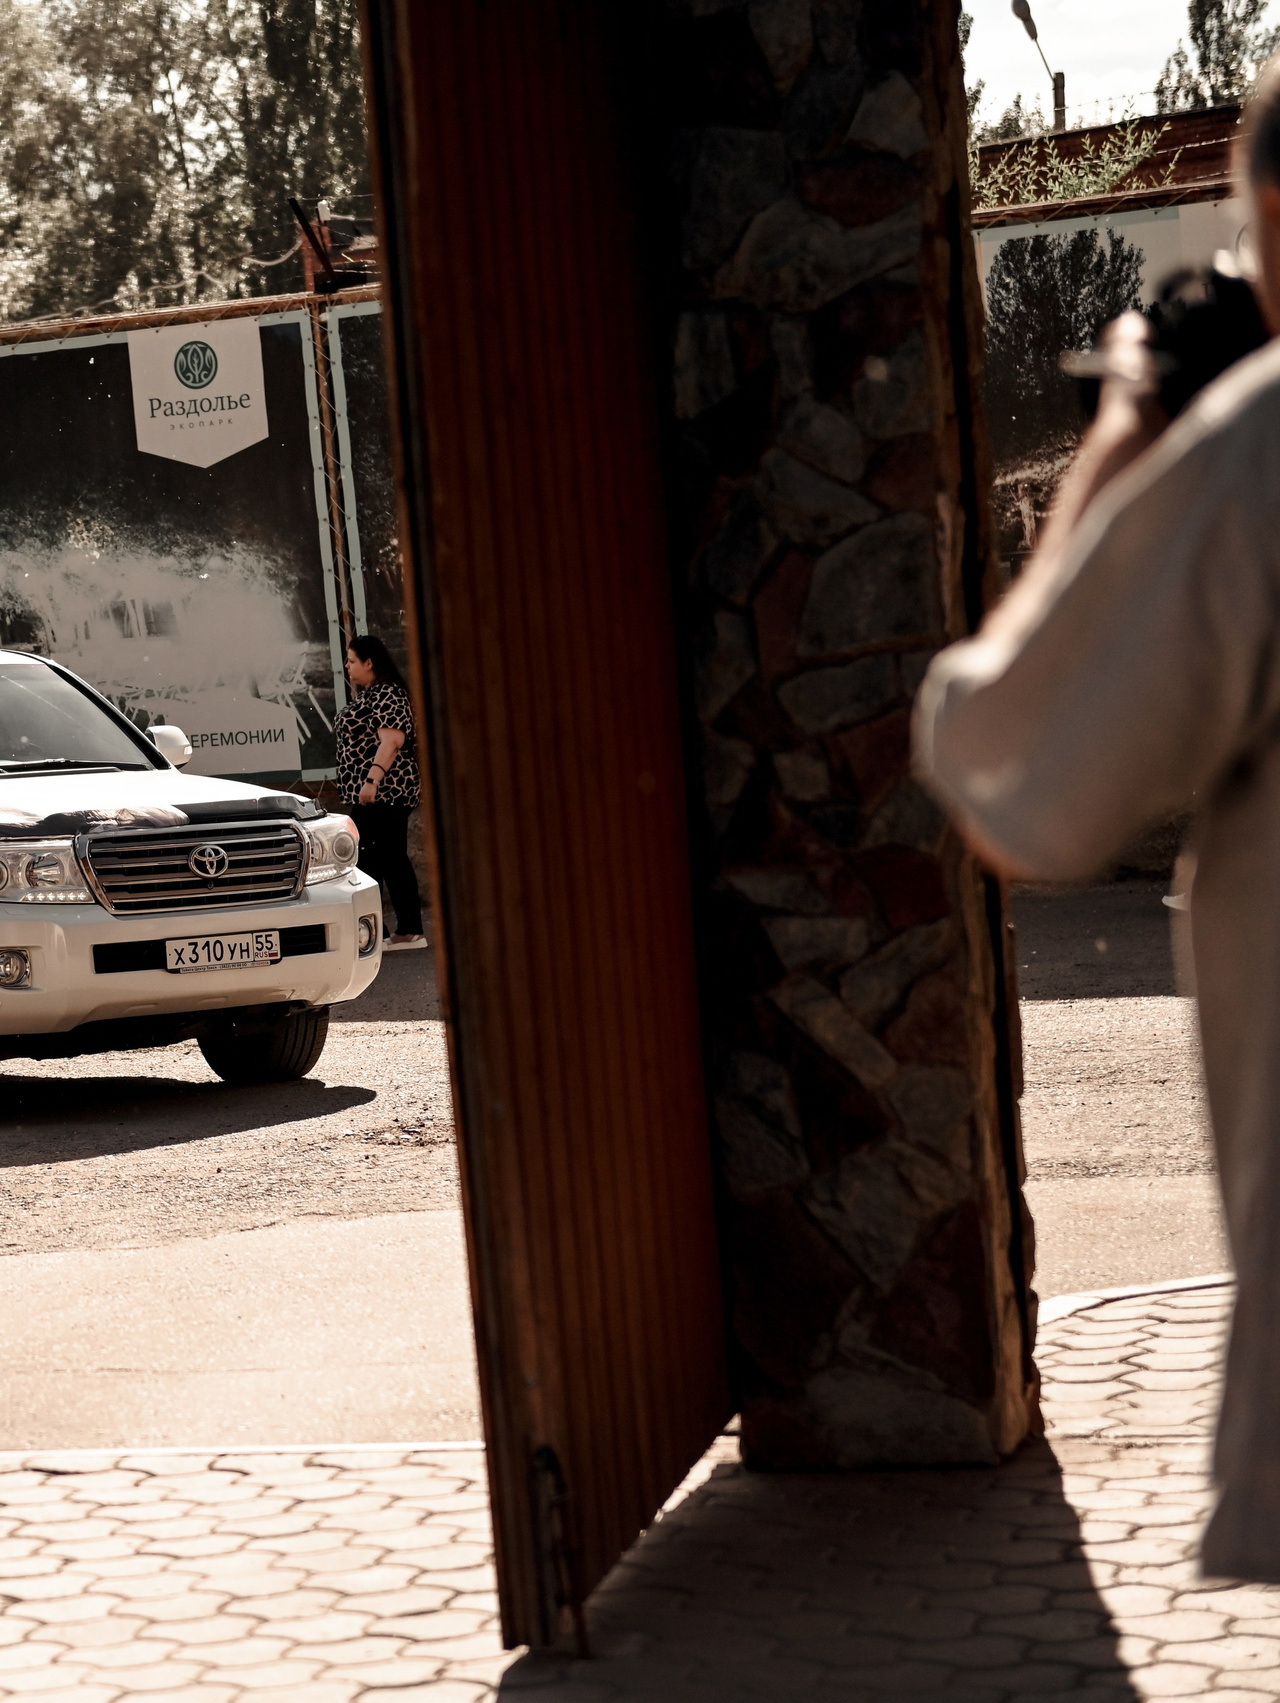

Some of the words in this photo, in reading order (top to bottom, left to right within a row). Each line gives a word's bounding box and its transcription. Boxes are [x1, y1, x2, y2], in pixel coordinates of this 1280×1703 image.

[148, 393, 251, 418] Раздолье
[170, 418, 233, 431] ЭКОПАРК
[186, 728, 285, 749] ЕРЕМОНИИ
[255, 933, 275, 952] 55
[254, 950, 269, 959] RUS
